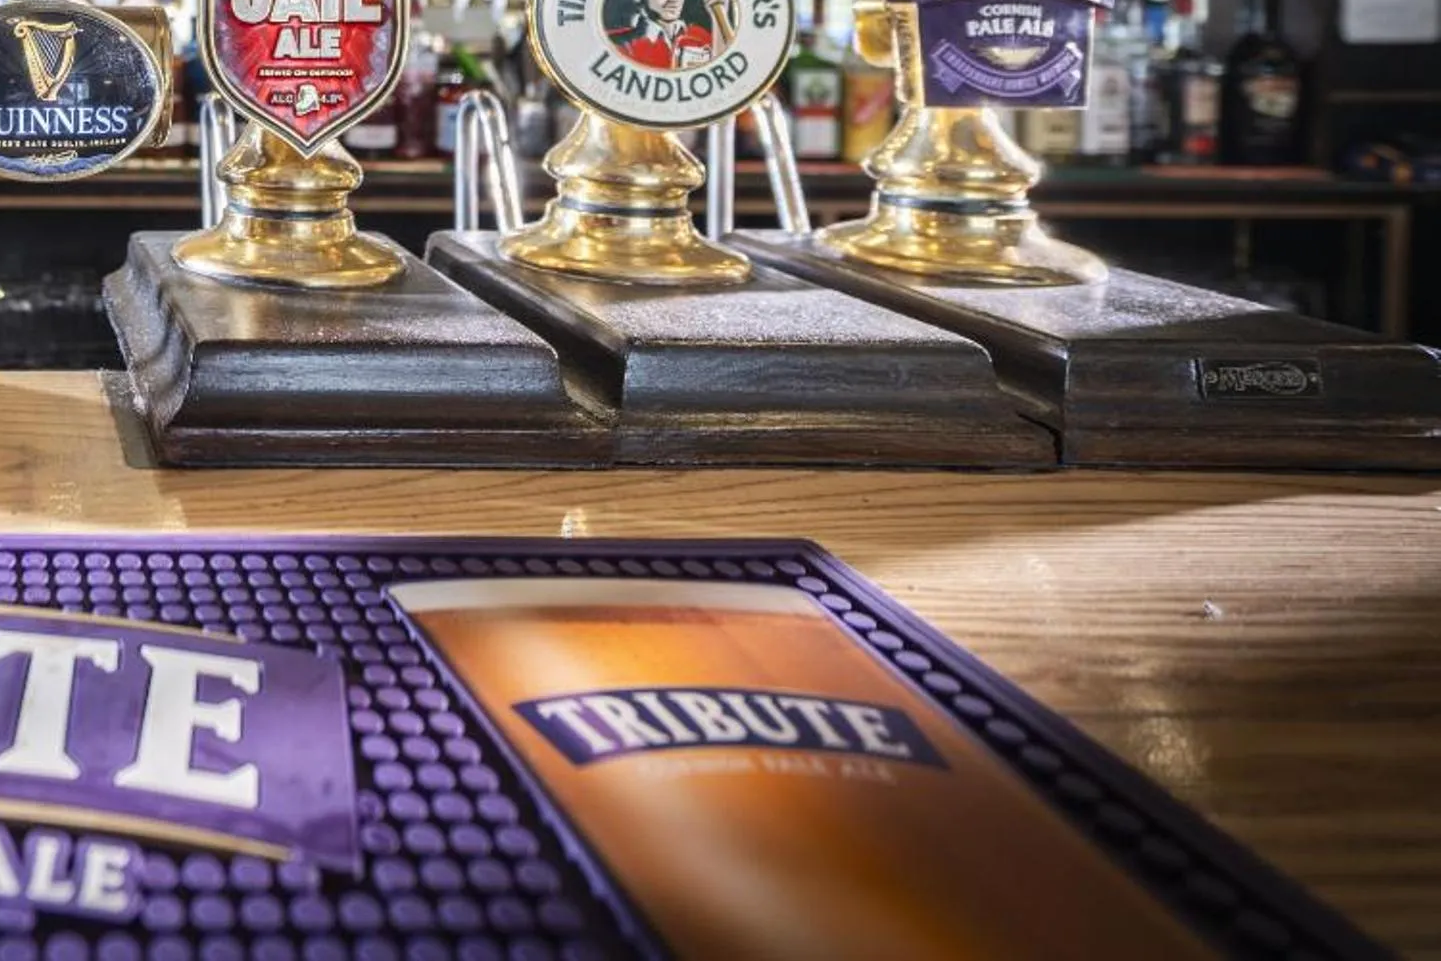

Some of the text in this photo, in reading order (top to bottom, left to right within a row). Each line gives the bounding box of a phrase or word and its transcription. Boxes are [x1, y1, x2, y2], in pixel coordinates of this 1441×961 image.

[979, 3, 1042, 18] CORNISH
[273, 27, 342, 59] ALE
[965, 18, 1055, 38] PALE ALE
[589, 49, 750, 103] LANDLORD
[537, 688, 912, 759] TRIBUTE
